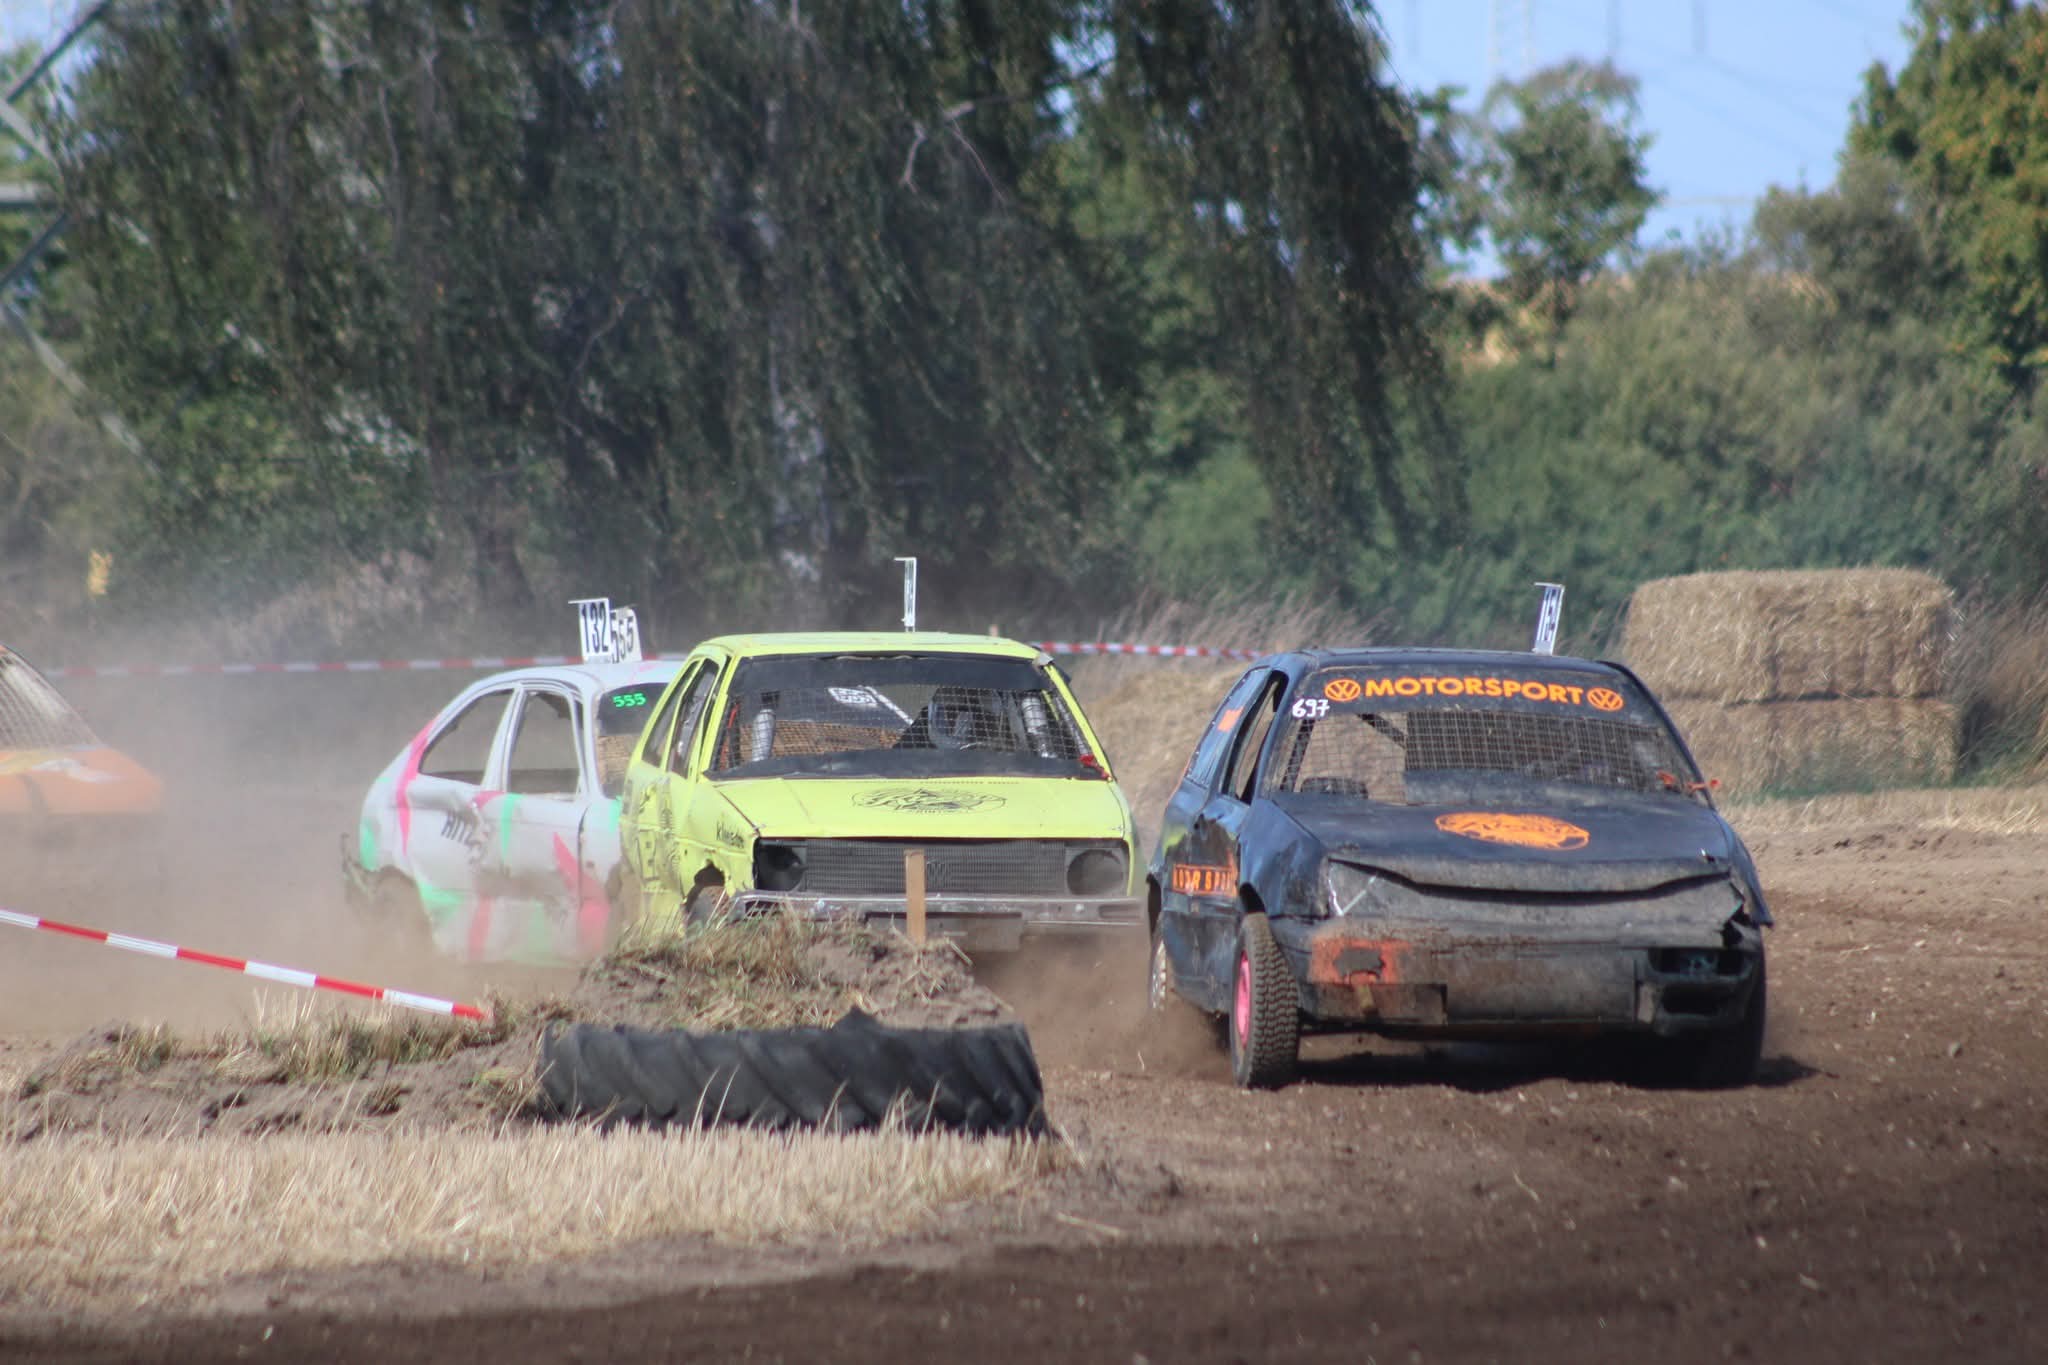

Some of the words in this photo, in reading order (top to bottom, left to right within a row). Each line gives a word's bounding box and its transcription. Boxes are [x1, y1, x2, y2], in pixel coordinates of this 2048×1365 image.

[581, 601, 609, 654] 132
[612, 693, 646, 707] 555
[1364, 677, 1583, 705] MOTORSPORT
[1292, 698, 1330, 718] 697
